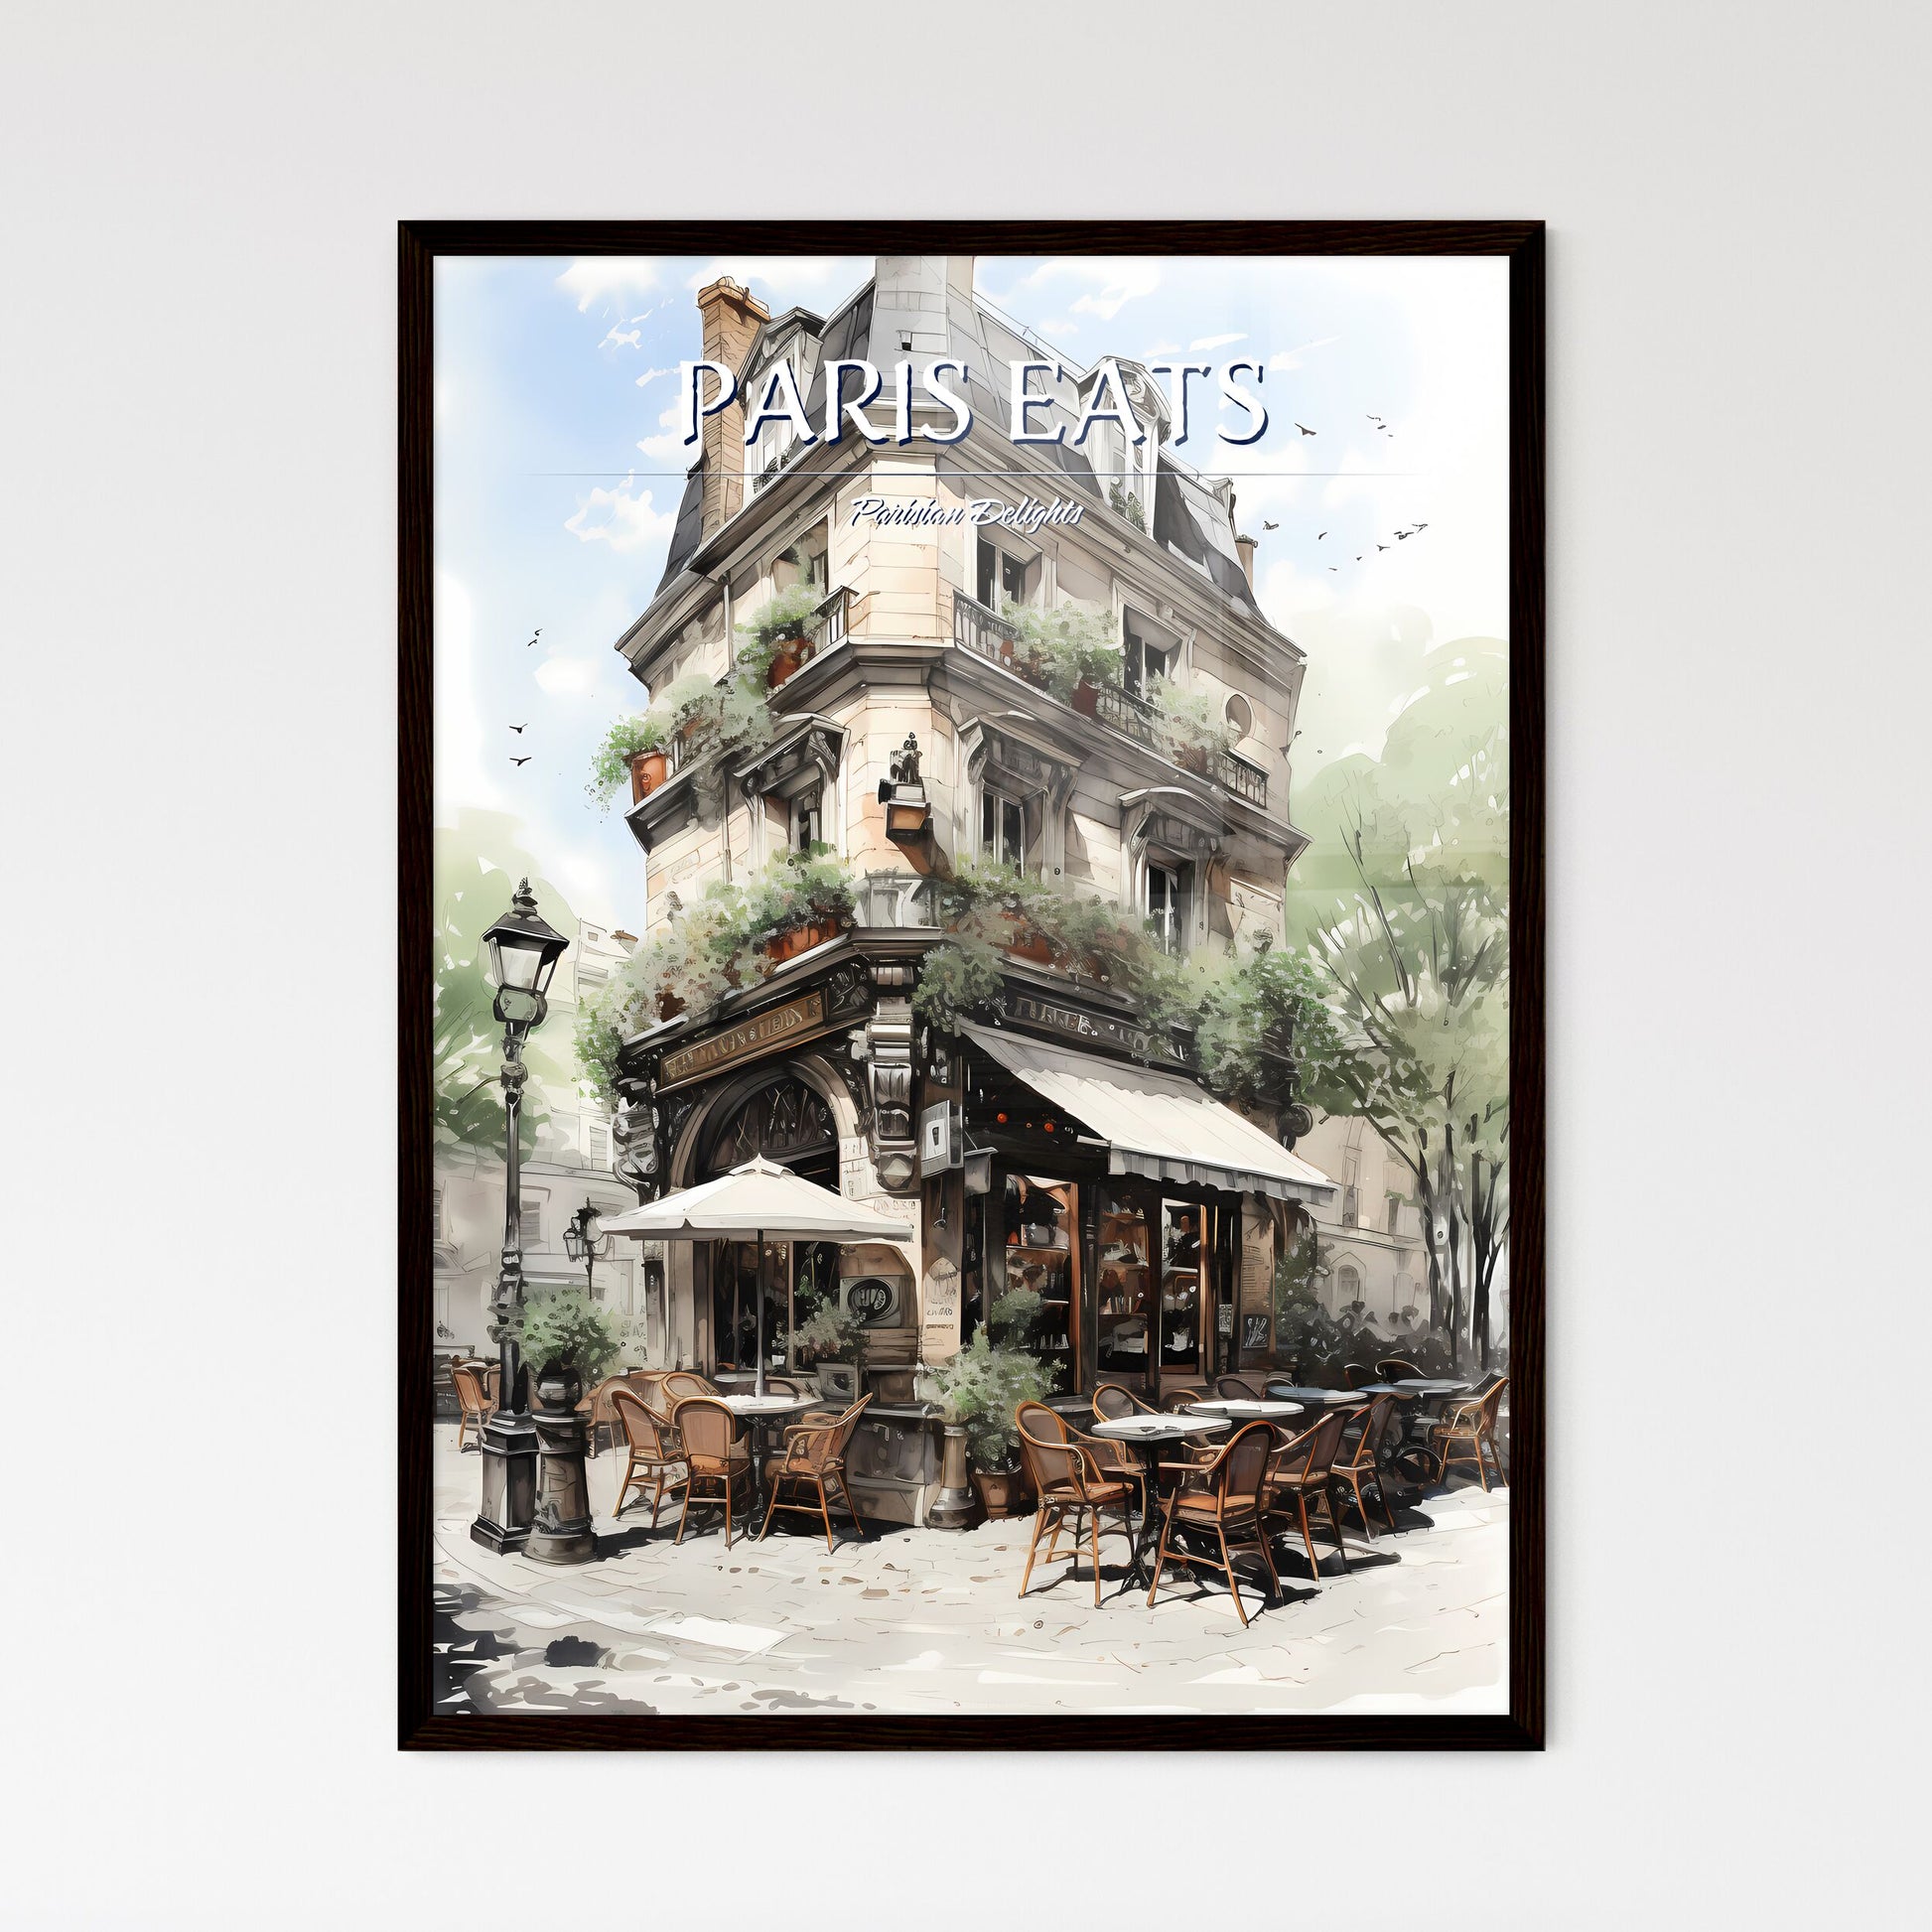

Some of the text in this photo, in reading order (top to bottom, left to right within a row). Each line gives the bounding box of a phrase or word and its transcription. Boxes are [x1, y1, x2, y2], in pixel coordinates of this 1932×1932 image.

[679, 357, 1268, 446] PARIS EATS
[851, 495, 1085, 534] Parisian Delights
